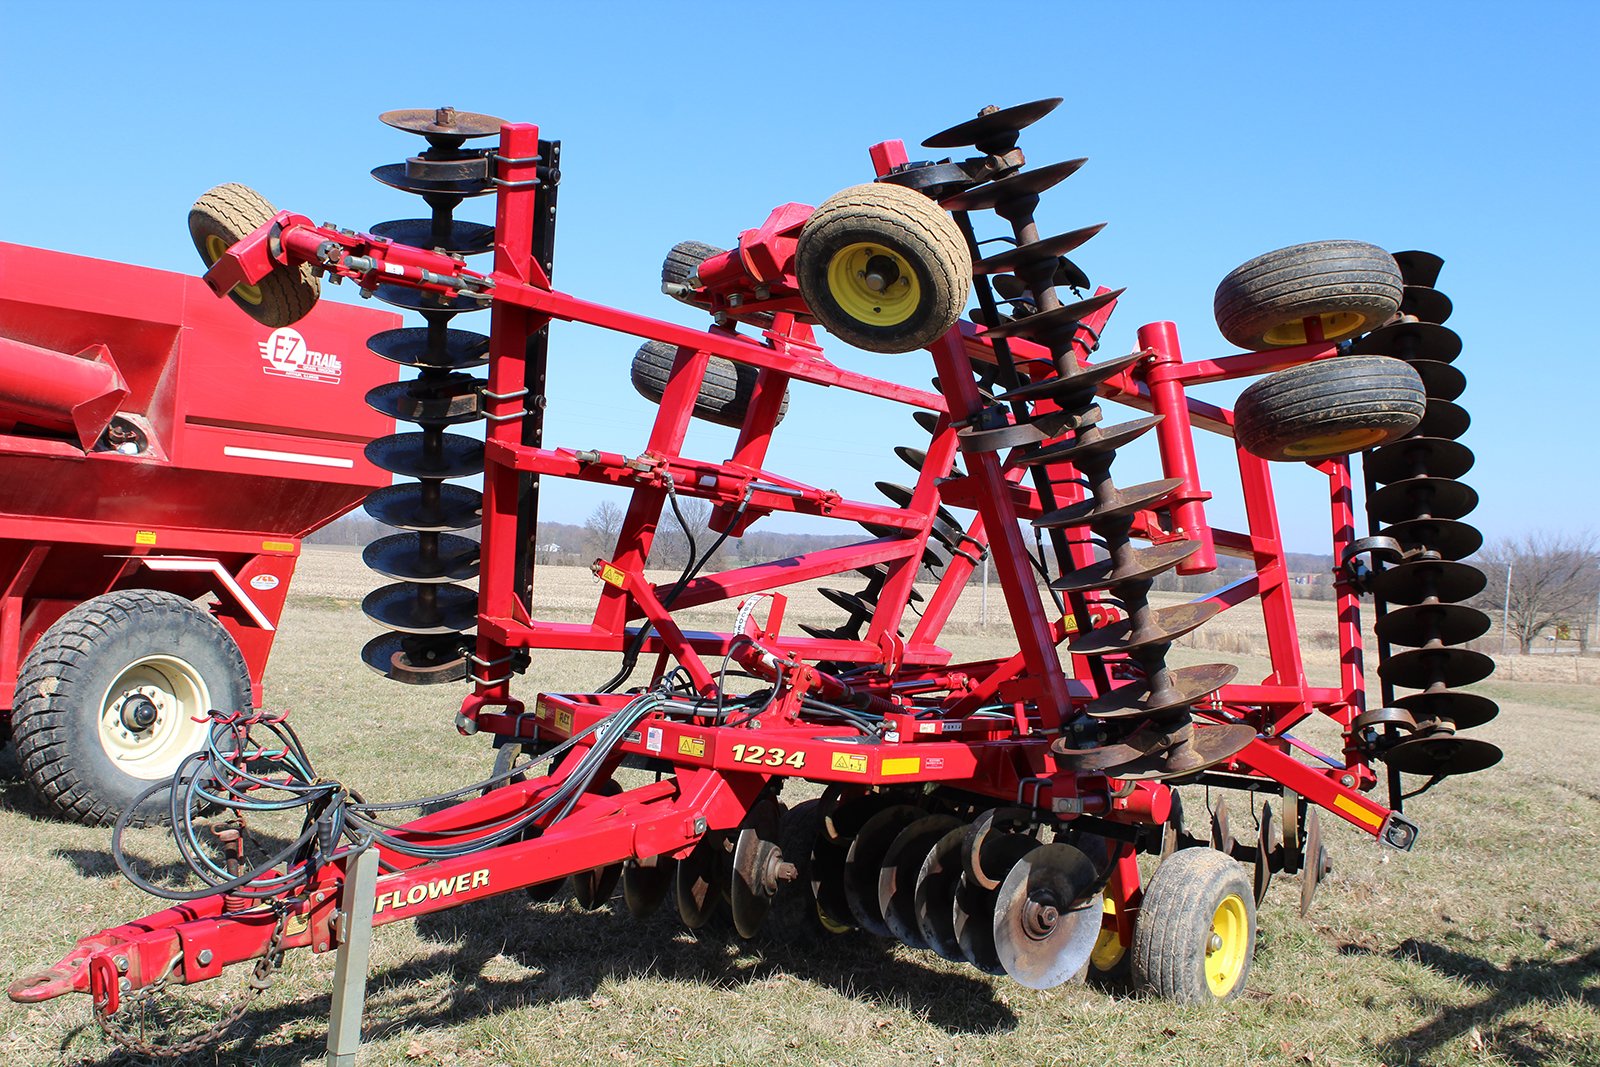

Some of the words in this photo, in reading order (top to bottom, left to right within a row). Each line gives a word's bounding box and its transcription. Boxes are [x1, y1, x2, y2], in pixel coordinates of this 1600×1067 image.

[306, 350, 337, 369] TRAIL
[732, 743, 806, 769] 1234
[374, 868, 490, 914] FLOWER
